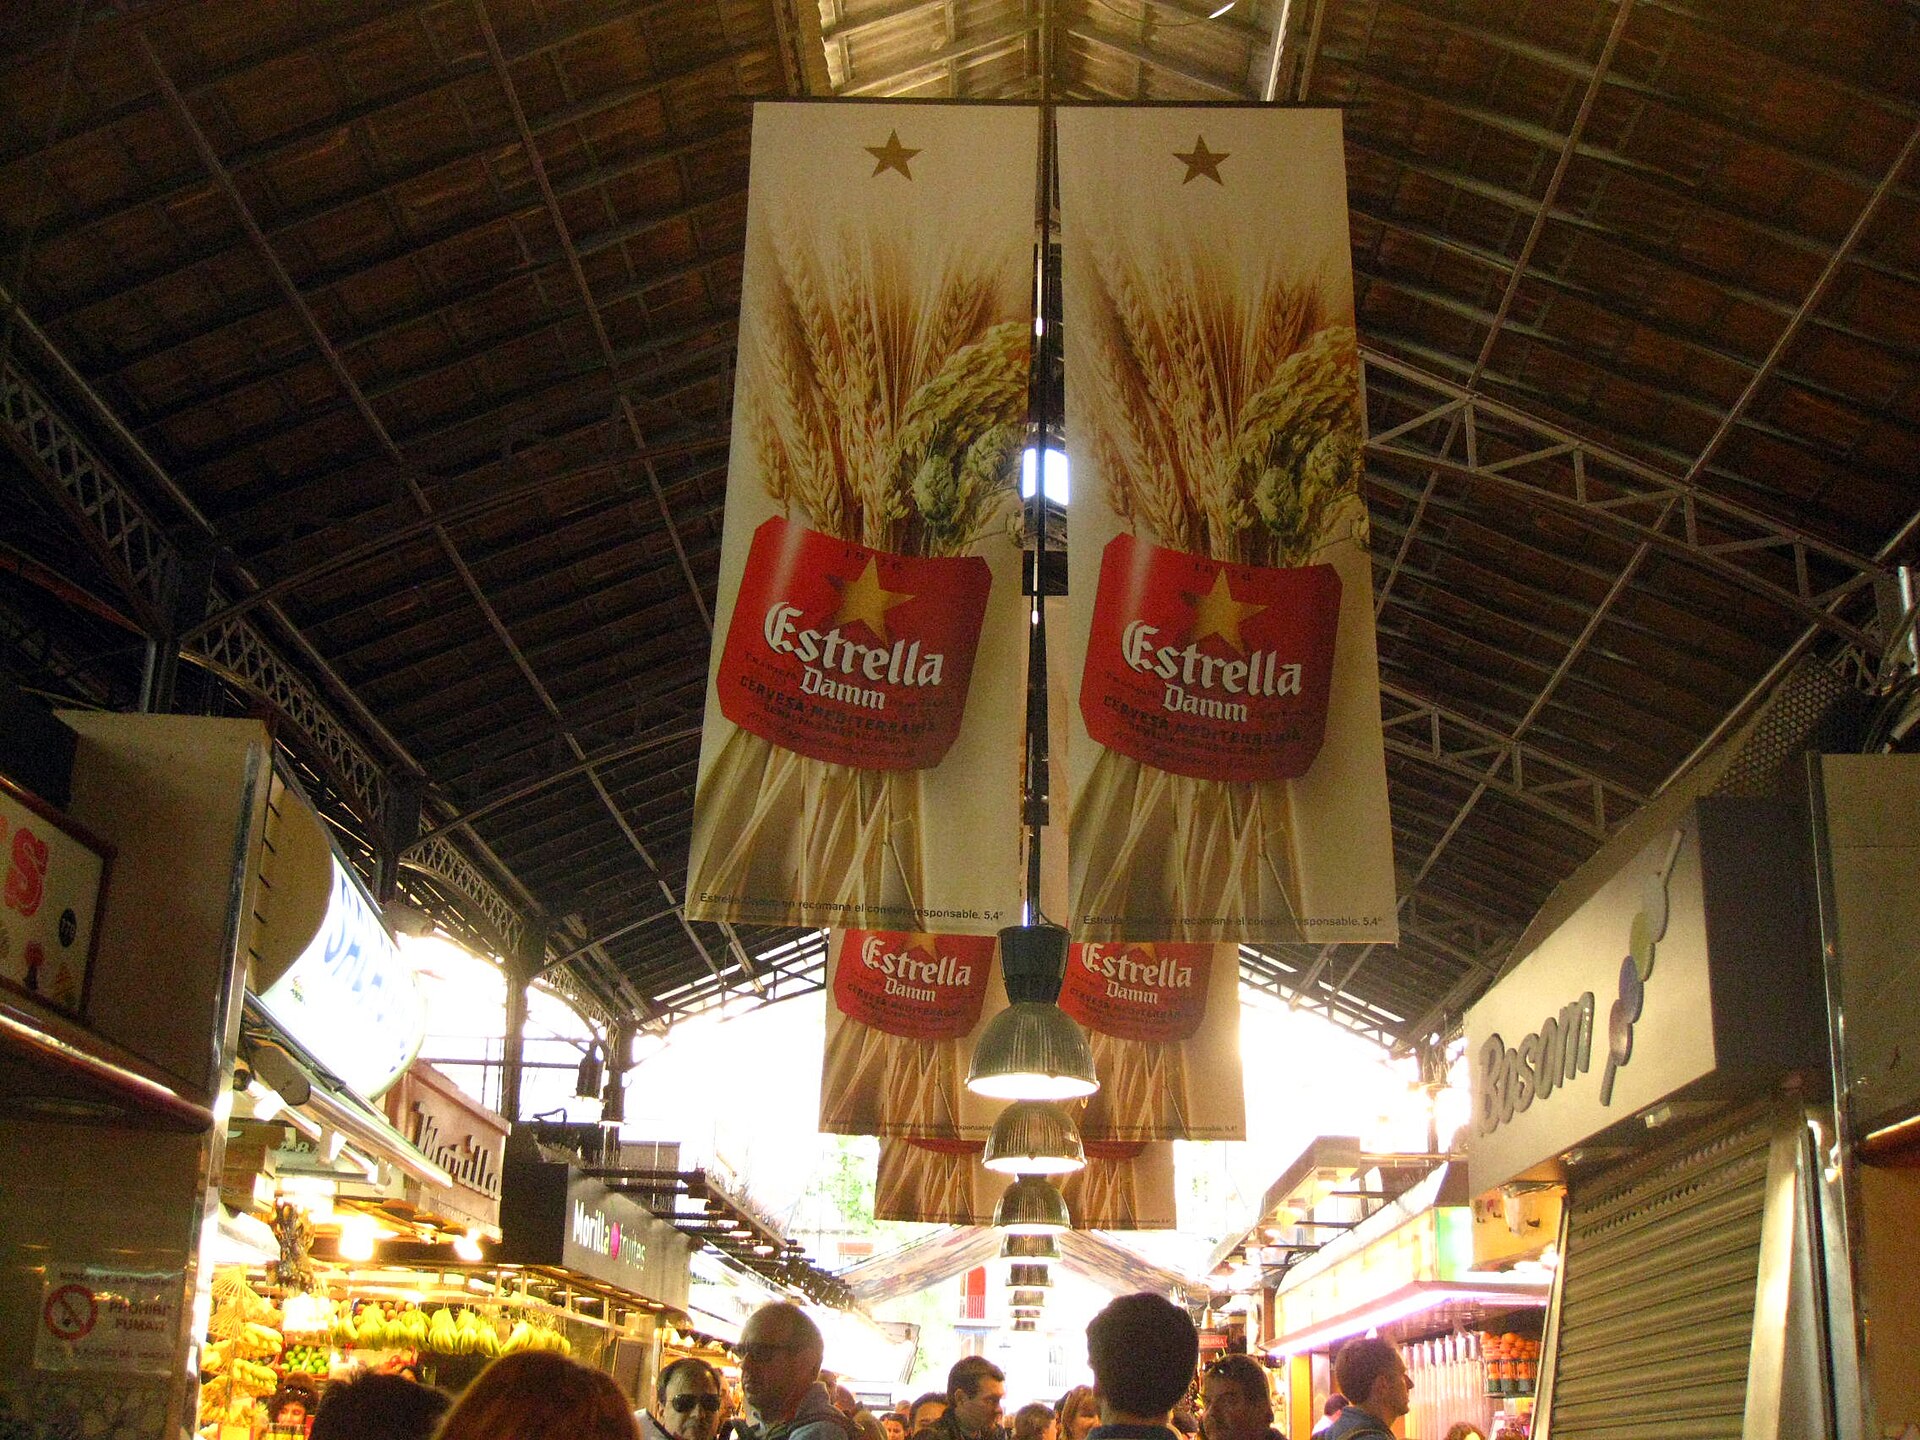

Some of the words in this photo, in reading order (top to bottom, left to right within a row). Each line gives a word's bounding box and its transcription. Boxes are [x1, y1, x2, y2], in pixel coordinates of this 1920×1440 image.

[764, 601, 944, 687] Estrella
[1121, 619, 1303, 697] Estrella
[799, 664, 886, 710] Damm
[1162, 682, 1248, 723] Damm
[861, 935, 972, 986] Estrella
[1081, 943, 1192, 988] Estrella
[883, 975, 937, 1002] Damm
[1105, 978, 1158, 1005] Damm
[572, 1199, 610, 1257] Morilla
[619, 1222, 646, 1272] fruites
